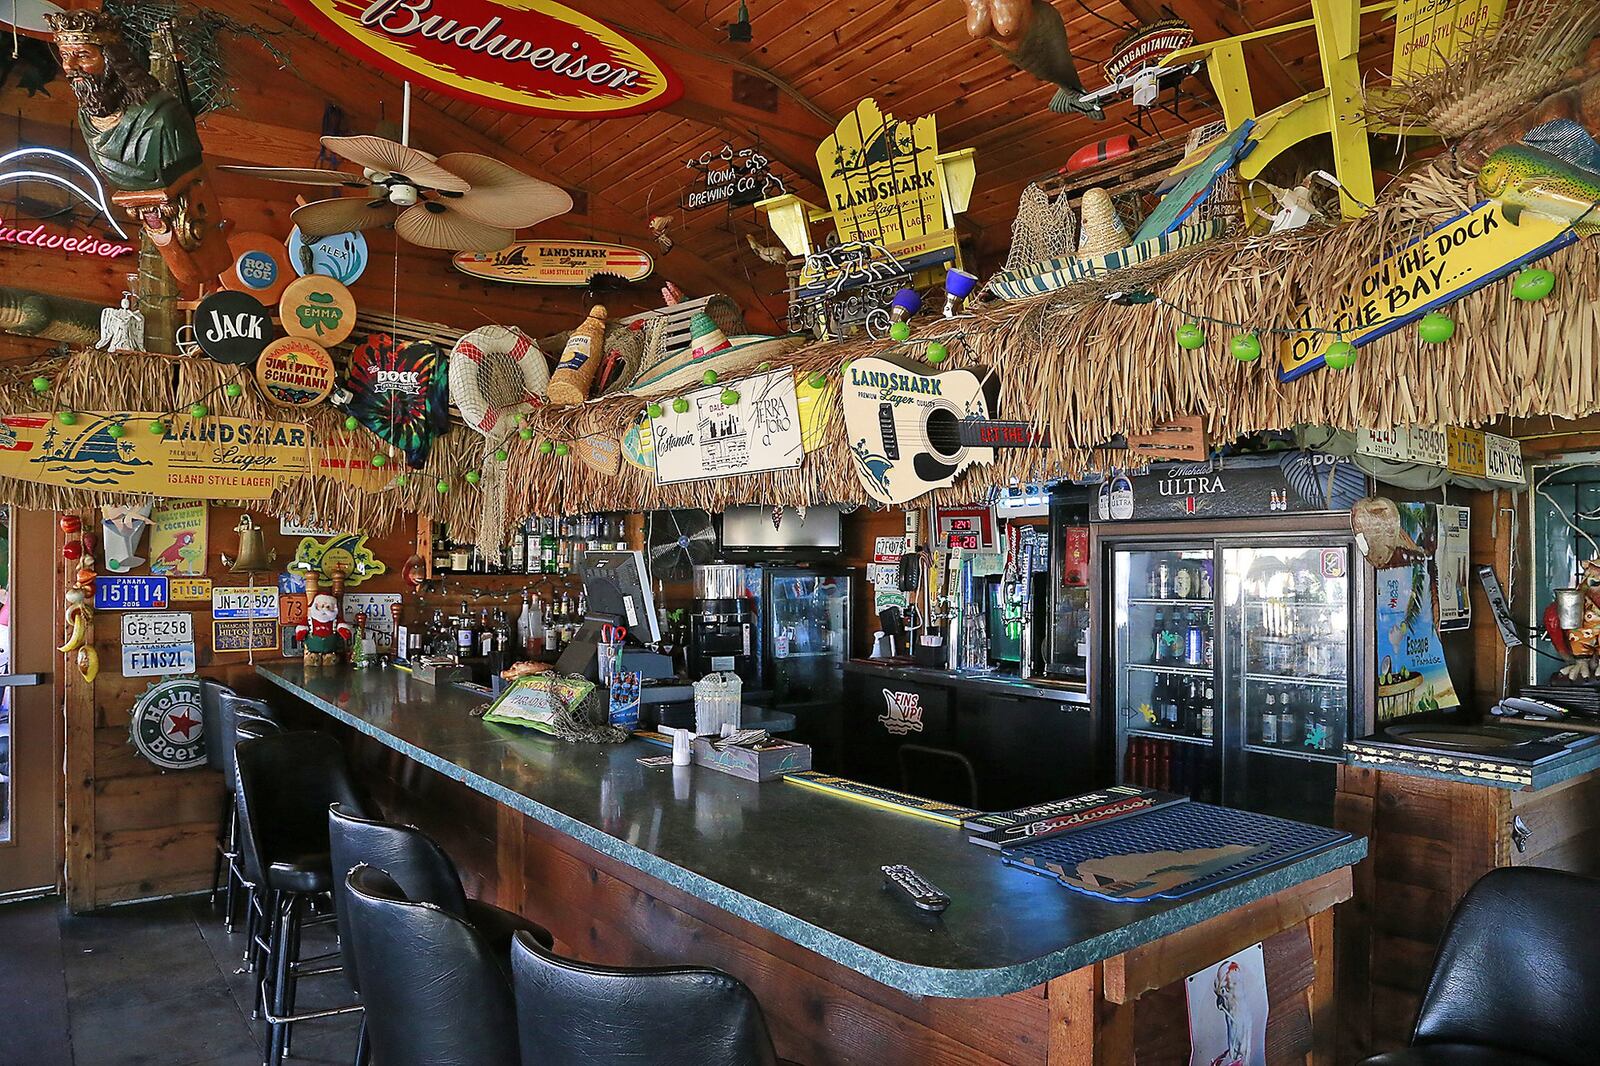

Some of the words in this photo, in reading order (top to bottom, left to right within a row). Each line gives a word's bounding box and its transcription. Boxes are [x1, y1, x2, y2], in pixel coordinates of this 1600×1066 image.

[1110, 35, 1186, 76] MARGARITAVILLE
[707, 167, 736, 185] KONA
[688, 183, 734, 207] BREWING
[835, 170, 935, 211] LANDSHARK
[0, 218, 132, 258] udweiser
[1436, 208, 1497, 256] DOCK
[319, 244, 348, 260] ALEX
[539, 247, 607, 258] LANDSHARK
[244, 257, 272, 271] ROS
[559, 257, 587, 268] Lager
[243, 268, 272, 282] COE
[304, 307, 338, 319] EMMA
[206, 310, 264, 343] JACK
[266, 357, 287, 370] JIM
[295, 363, 328, 376] PATTY
[264, 369, 328, 390] SCHUMANN
[377, 371, 419, 384] DOCK
[851, 368, 942, 396] LANDSHARK
[858, 391, 877, 400] PREMIUM
[879, 388, 915, 408] Lager
[656, 425, 695, 457] Estancia
[980, 427, 999, 442] LET
[1001, 427, 1024, 443] THE
[212, 446, 277, 472] Lager
[168, 474, 204, 485] ISLAND
[208, 475, 237, 486] STYLE
[241, 476, 271, 487] LAGER
[1159, 475, 1226, 496] ULTRA
[172, 500, 203, 510] CRACKER
[101, 585, 162, 602] 151114
[131, 652, 185, 669] FINS2L
[895, 693, 918, 707] FINS
[148, 736, 199, 760] Beer
[1005, 797, 1157, 836] Budweiser
